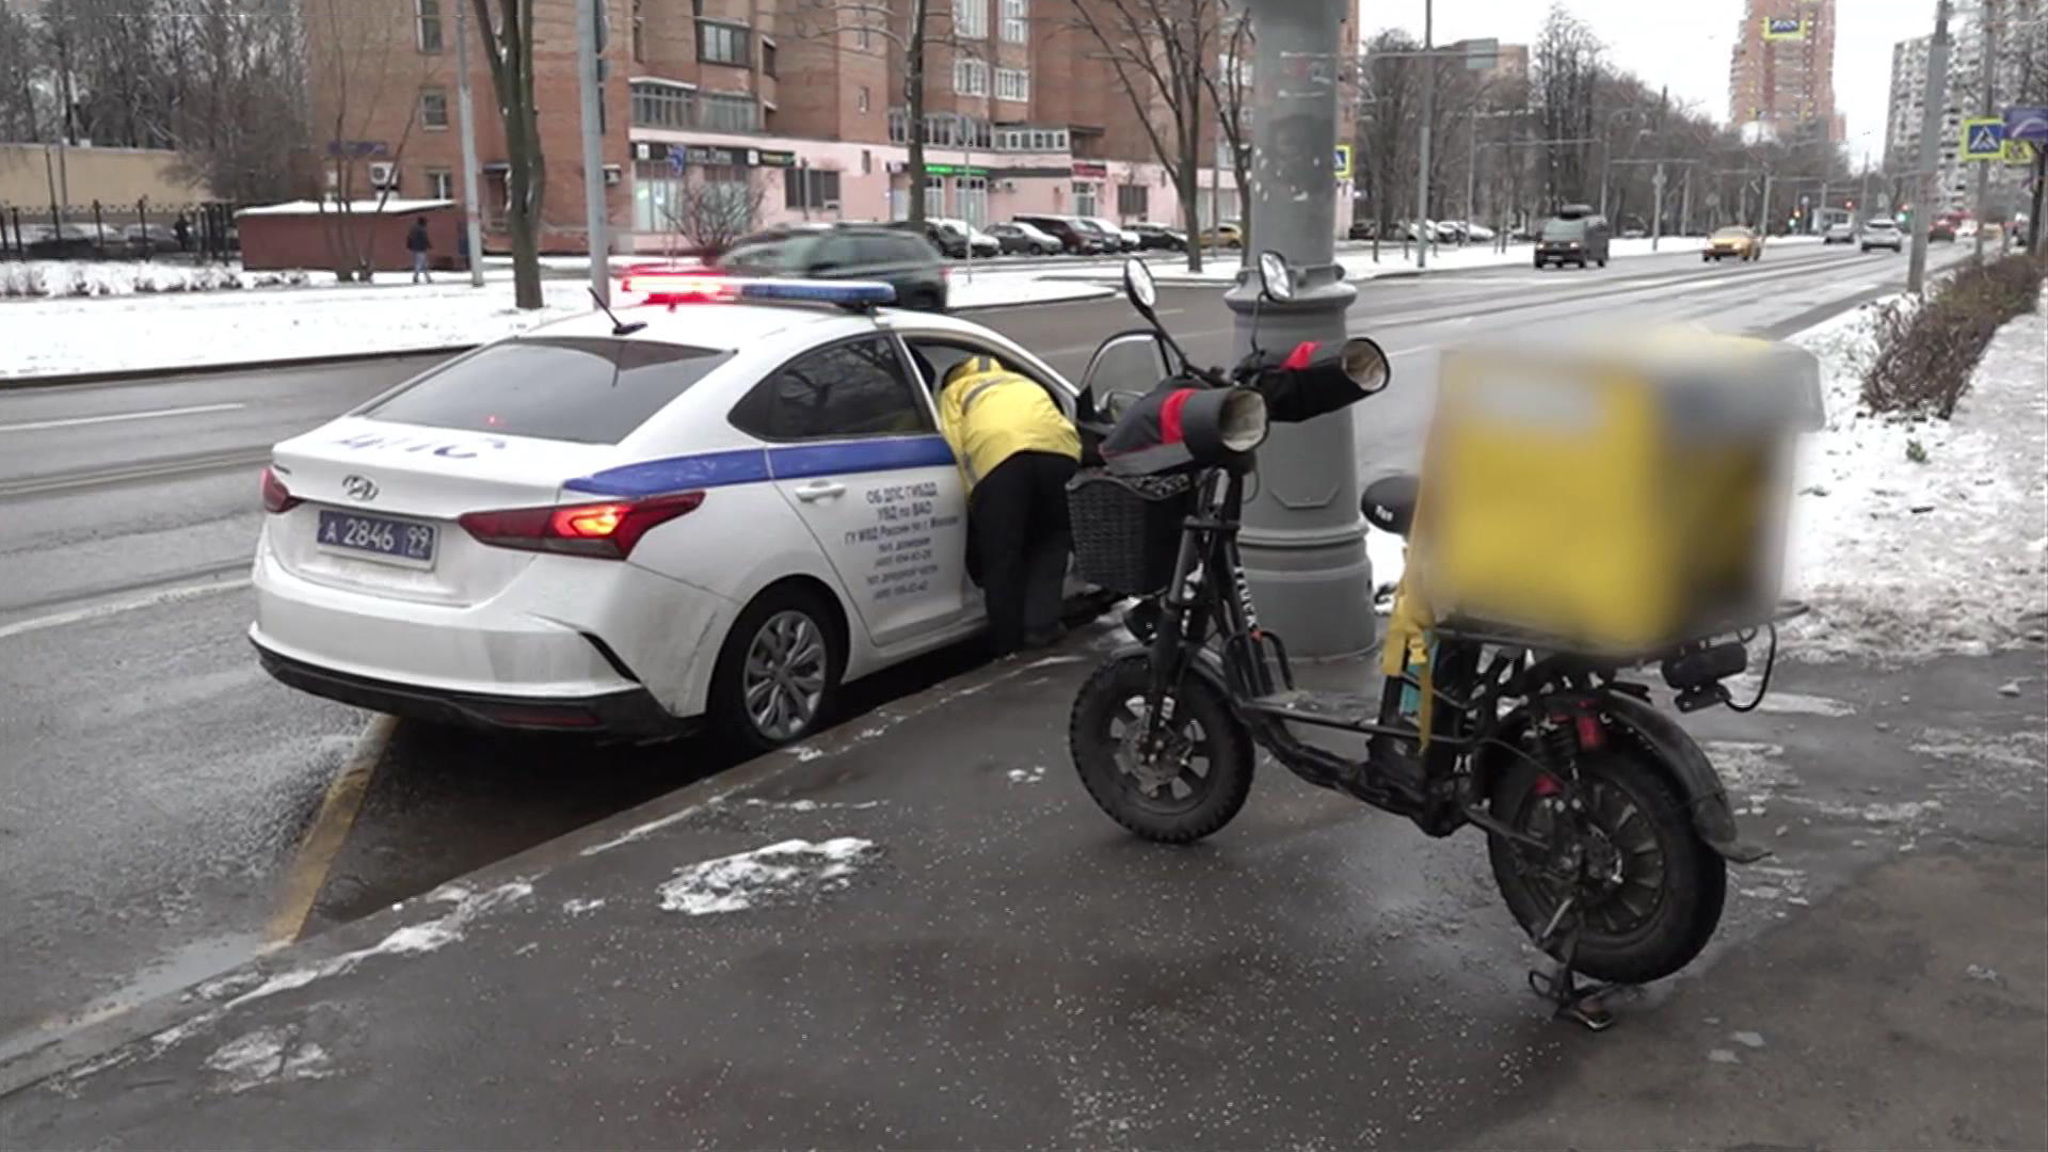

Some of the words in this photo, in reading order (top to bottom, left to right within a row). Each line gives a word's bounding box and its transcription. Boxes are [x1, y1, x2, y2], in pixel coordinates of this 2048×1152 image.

[325, 521, 338, 542] А
[343, 518, 395, 551] 2846
[408, 526, 430, 549] 99
